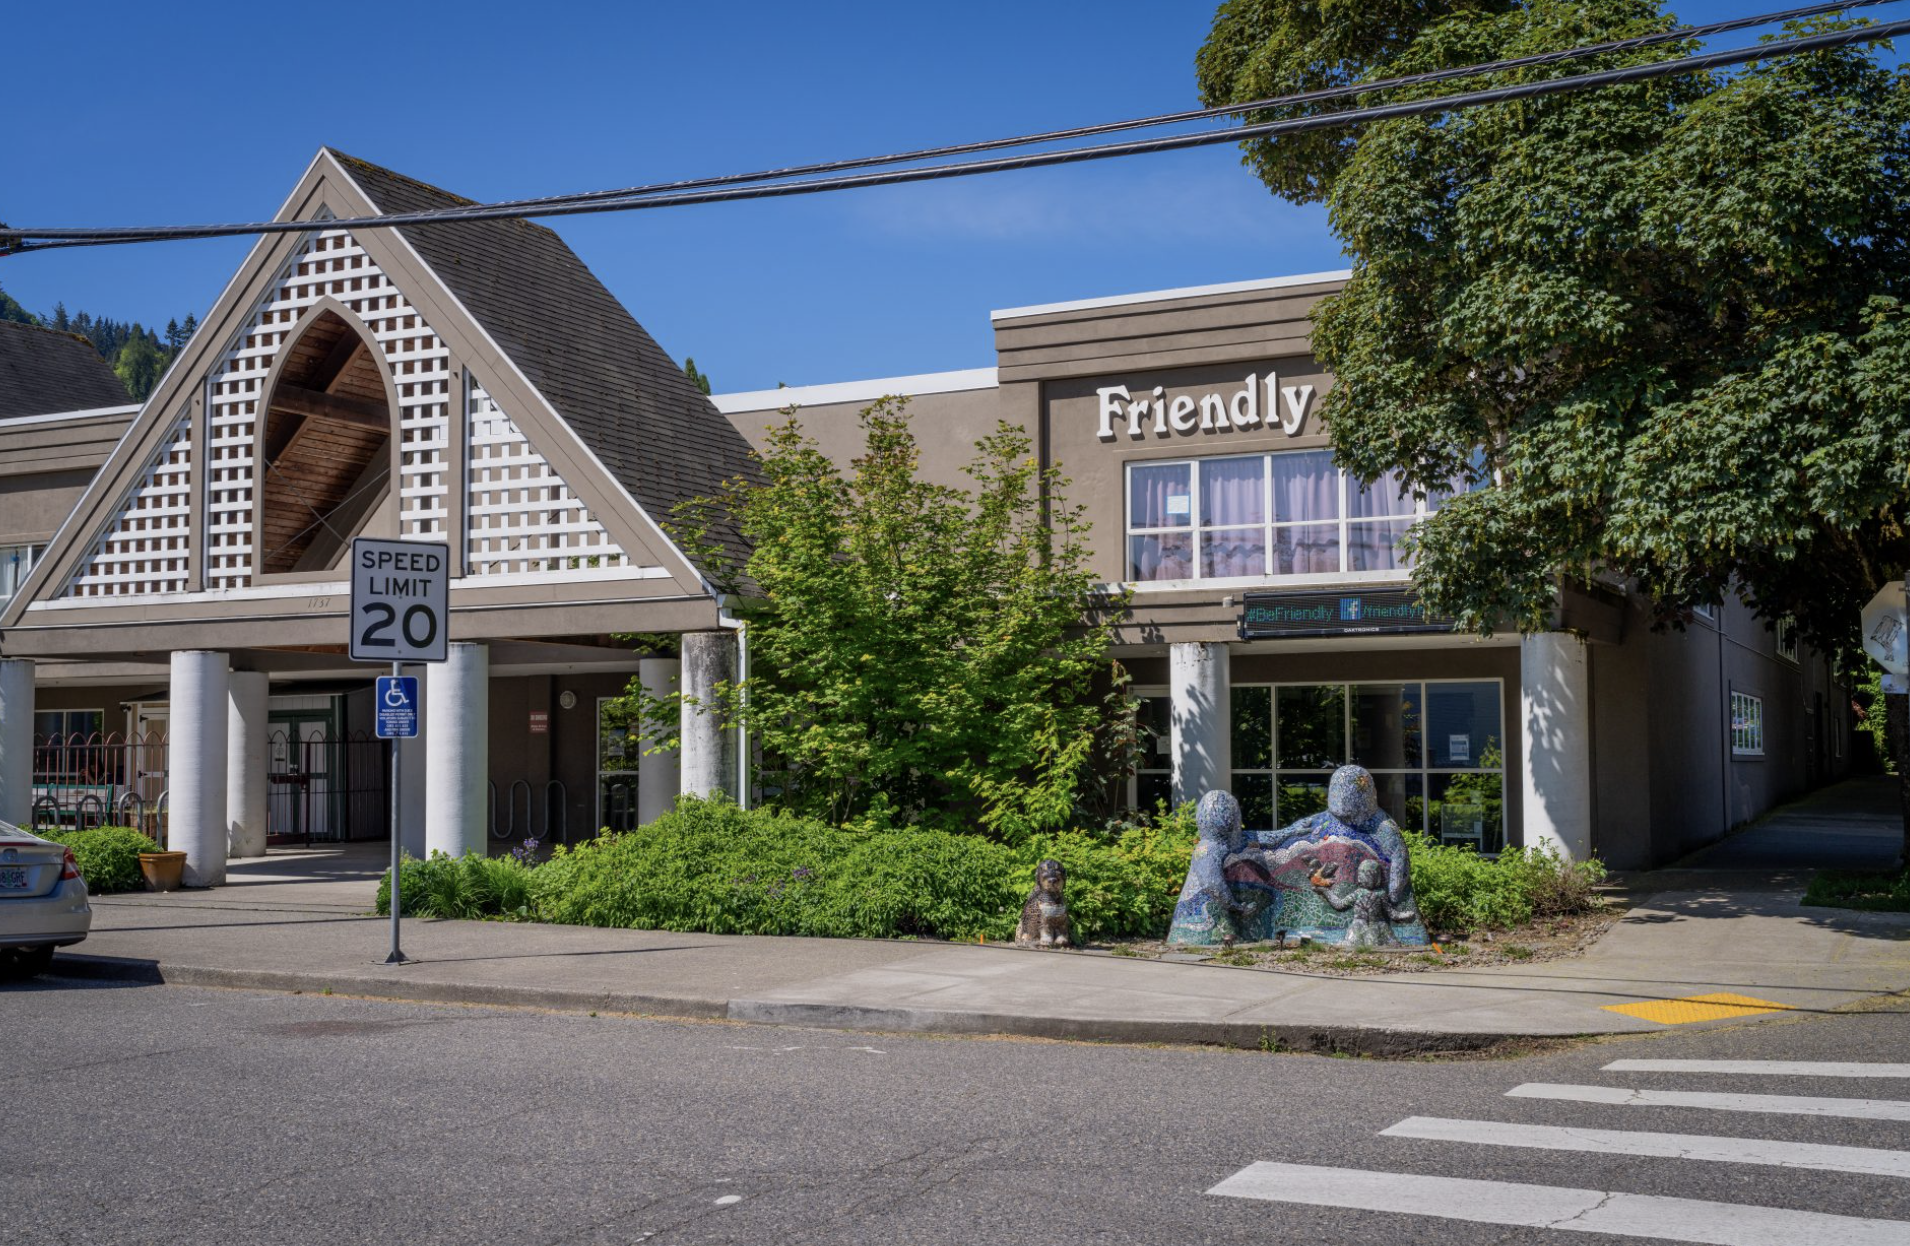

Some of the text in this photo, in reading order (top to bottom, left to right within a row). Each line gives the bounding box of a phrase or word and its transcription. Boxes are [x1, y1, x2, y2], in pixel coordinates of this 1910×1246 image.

[1096, 371, 1313, 435] Friendly
[362, 550, 440, 572] SPEED
[370, 577, 432, 597] LIMIT
[1247, 604, 1333, 621] #BeFriendly
[361, 602, 437, 648] 20
